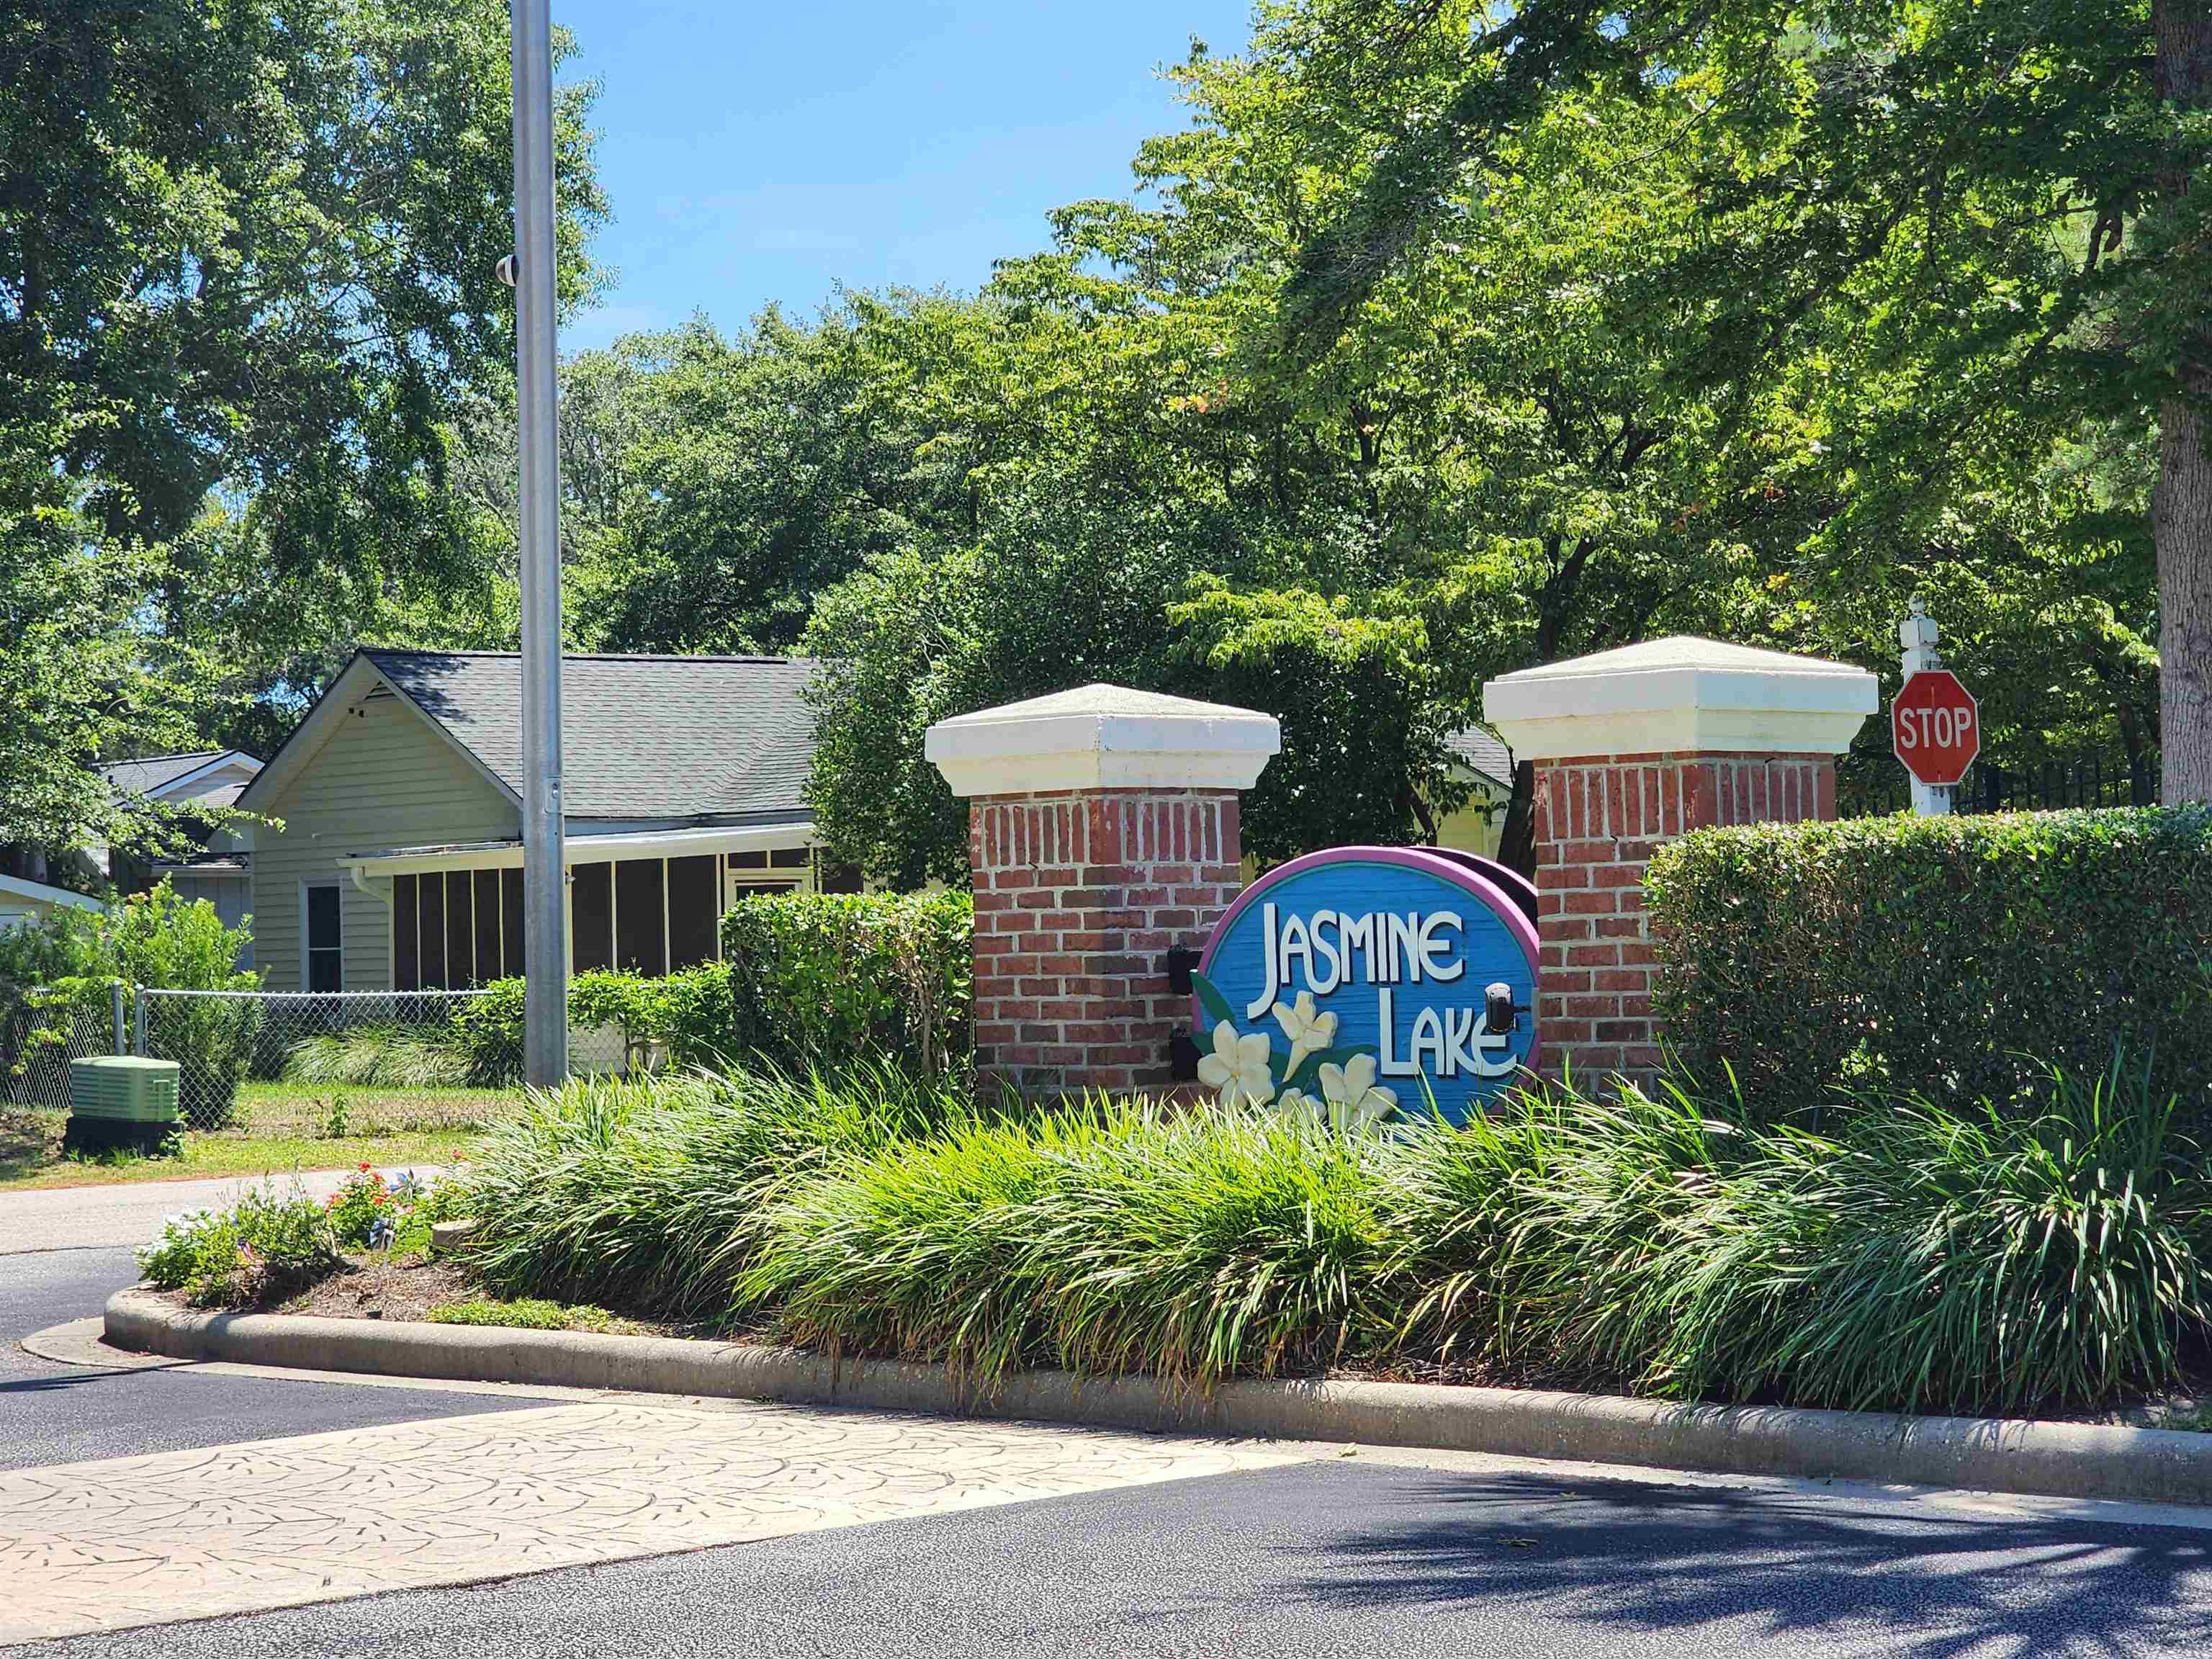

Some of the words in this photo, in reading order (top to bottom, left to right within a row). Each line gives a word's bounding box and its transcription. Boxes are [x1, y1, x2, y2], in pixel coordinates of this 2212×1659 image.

[1900, 707, 1972, 749] STOP
[1247, 903, 1463, 1019] JASMINE
[1379, 988, 1517, 1076] LAKE
